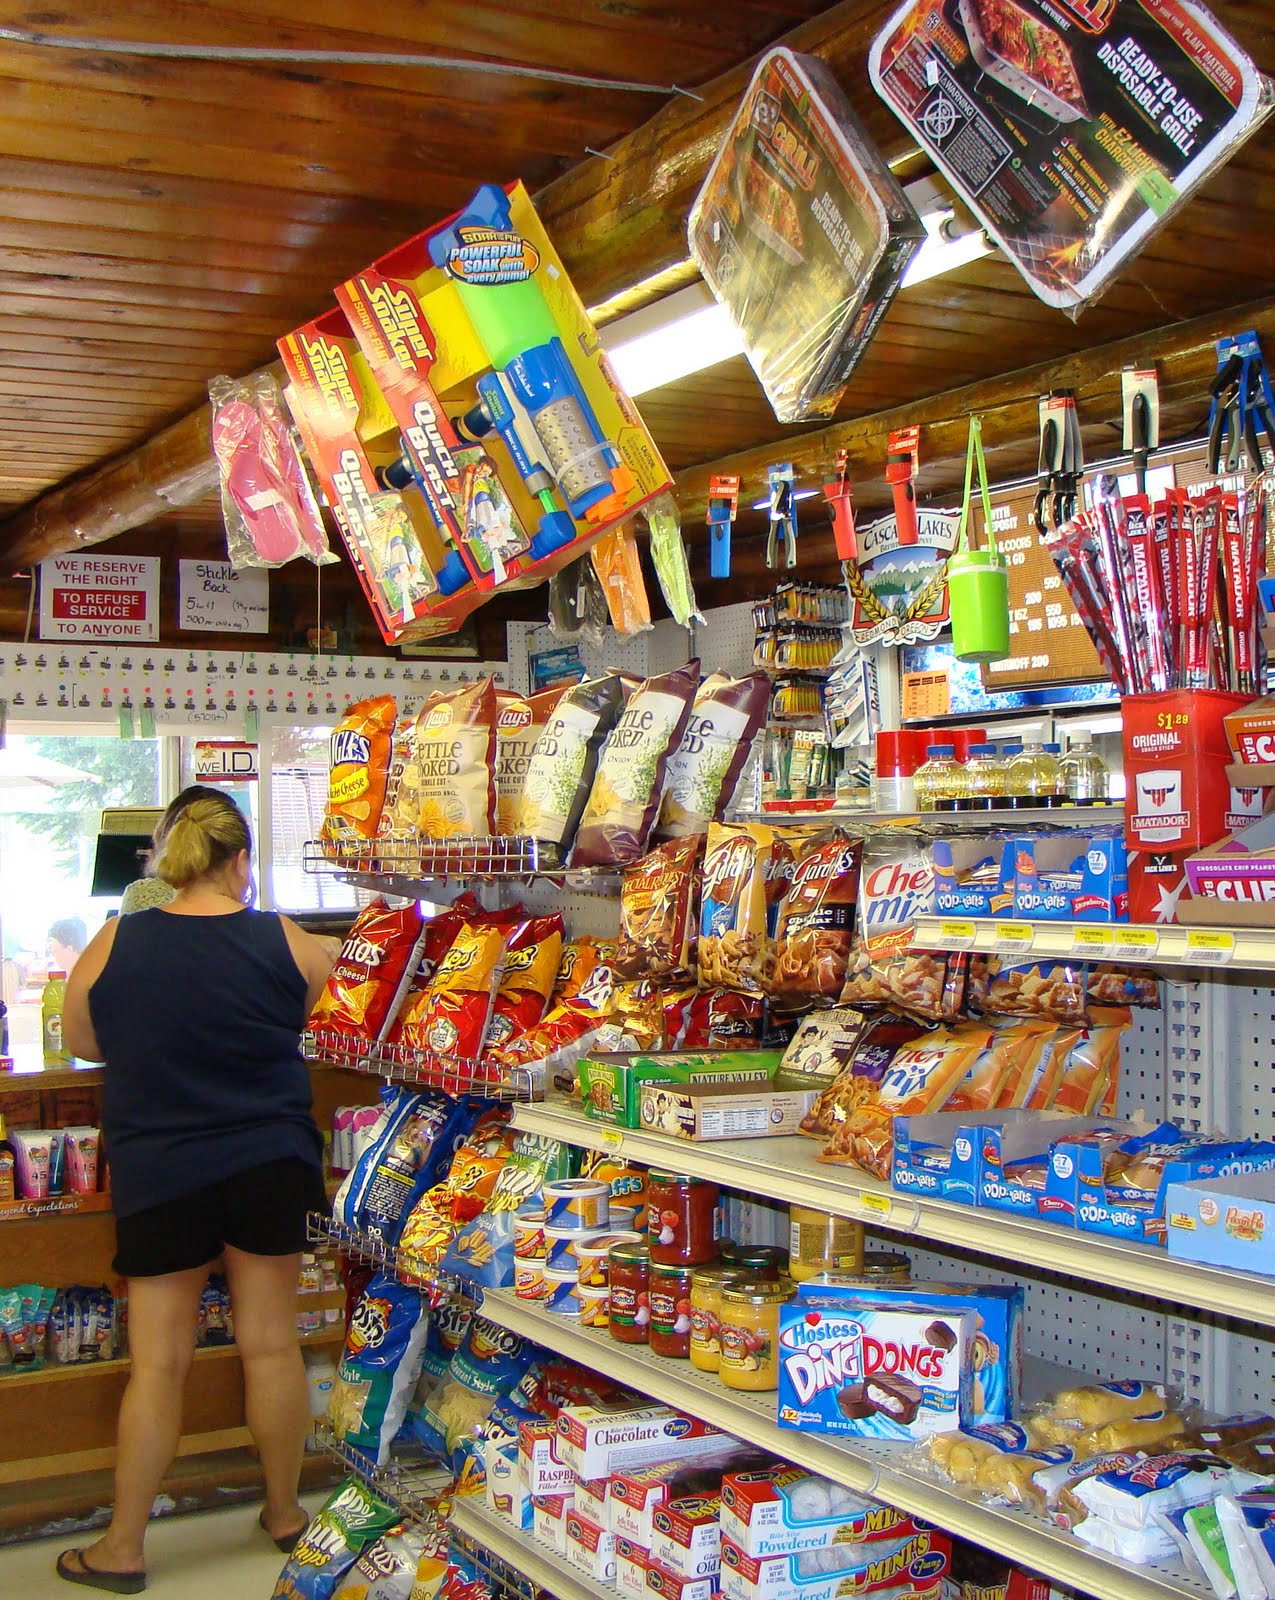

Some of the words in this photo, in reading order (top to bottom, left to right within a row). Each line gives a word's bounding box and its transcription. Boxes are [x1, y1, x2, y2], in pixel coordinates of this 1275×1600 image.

[1039, 0, 1072, 32] ANYWHERE!
[1181, 27, 1206, 54] PLANT
[1201, 50, 1238, 90] MATERIAL
[1115, 36, 1204, 133] READY-TO-USE
[941, 79, 976, 117] WARNING
[1093, 42, 1167, 121] DISPOSABLE
[1156, 115, 1196, 157] GRILL
[1097, 112, 1116, 132] WITH
[1112, 127, 1131, 145] EZ
[1126, 142, 1157, 174] LIGHT
[771, 121, 820, 191] GRILL
[1093, 127, 1142, 180] CHARCOAL
[811, 201, 846, 258] DISPOSABLE
[821, 191, 865, 266] READY-TO-USE
[450, 244, 524, 261] POWERFUL
[463, 258, 500, 273] SOAK
[501, 260, 524, 271] with
[467, 273, 496, 284] every
[496, 270, 530, 283] pump!
[406, 426, 456, 509] BLAST
[332, 473, 373, 551] BLAST
[864, 524, 898, 551] CASCA
[918, 516, 952, 540] LAKES
[1005, 536, 1032, 552] COORS
[55, 560, 78, 571] WE
[83, 561, 146, 574] RESERVE
[63, 573, 91, 585] THE
[95, 574, 138, 586] RIGHT
[1185, 537, 1195, 617] MATADOR
[1230, 541, 1244, 619] MATADOR
[60, 592, 82, 604] TO
[85, 593, 140, 606] REFUSE
[186, 596, 196, 610] 5
[1024, 591, 1042, 606] 200
[69, 605, 130, 617] SERVICE
[57, 623, 78, 634] TO
[81, 623, 142, 636] ANYONE
[860, 618, 899, 641] REDMOND
[901, 624, 929, 636] OREGON
[1031, 654, 1049, 669] 200
[869, 655, 881, 712] Rolaids
[1157, 712, 1189, 730] $1.29
[795, 731, 826, 743] REPEL
[1132, 732, 1181, 749] ORIGINAL
[1243, 737, 1258, 763] BAR
[197, 762, 220, 773] WE
[222, 752, 256, 772] I.D.
[341, 777, 365, 795] Cheese
[1135, 815, 1186, 828] MATADOR
[623, 876, 652, 893] PECIAL
[1074, 900, 1106, 912] Strawberry
[337, 965, 366, 982] Cheese
[692, 1075, 731, 1084] NATURE
[732, 1072, 767, 1082] VALLEY
[31, 1170, 47, 1180] 45
[82, 1162, 96, 1173] 15
[0, 1203, 26, 1217] eyond
[27, 1200, 80, 1215] Expectations
[1044, 1200, 1064, 1209] Cherry
[793, 1323, 858, 1346] Hostess
[862, 1336, 946, 1379] DONGS
[343, 1372, 361, 1382] Style
[472, 1376, 496, 1393] Style
[783, 1409, 798, 1421] 12
[594, 1427, 659, 1446] Chocolate
[538, 1470, 575, 1482] RASPBE
[538, 1482, 558, 1490] Filled
[758, 1533, 827, 1554] Powdered
[769, 1532, 784, 1540] Bite
[696, 1560, 716, 1574] Old
